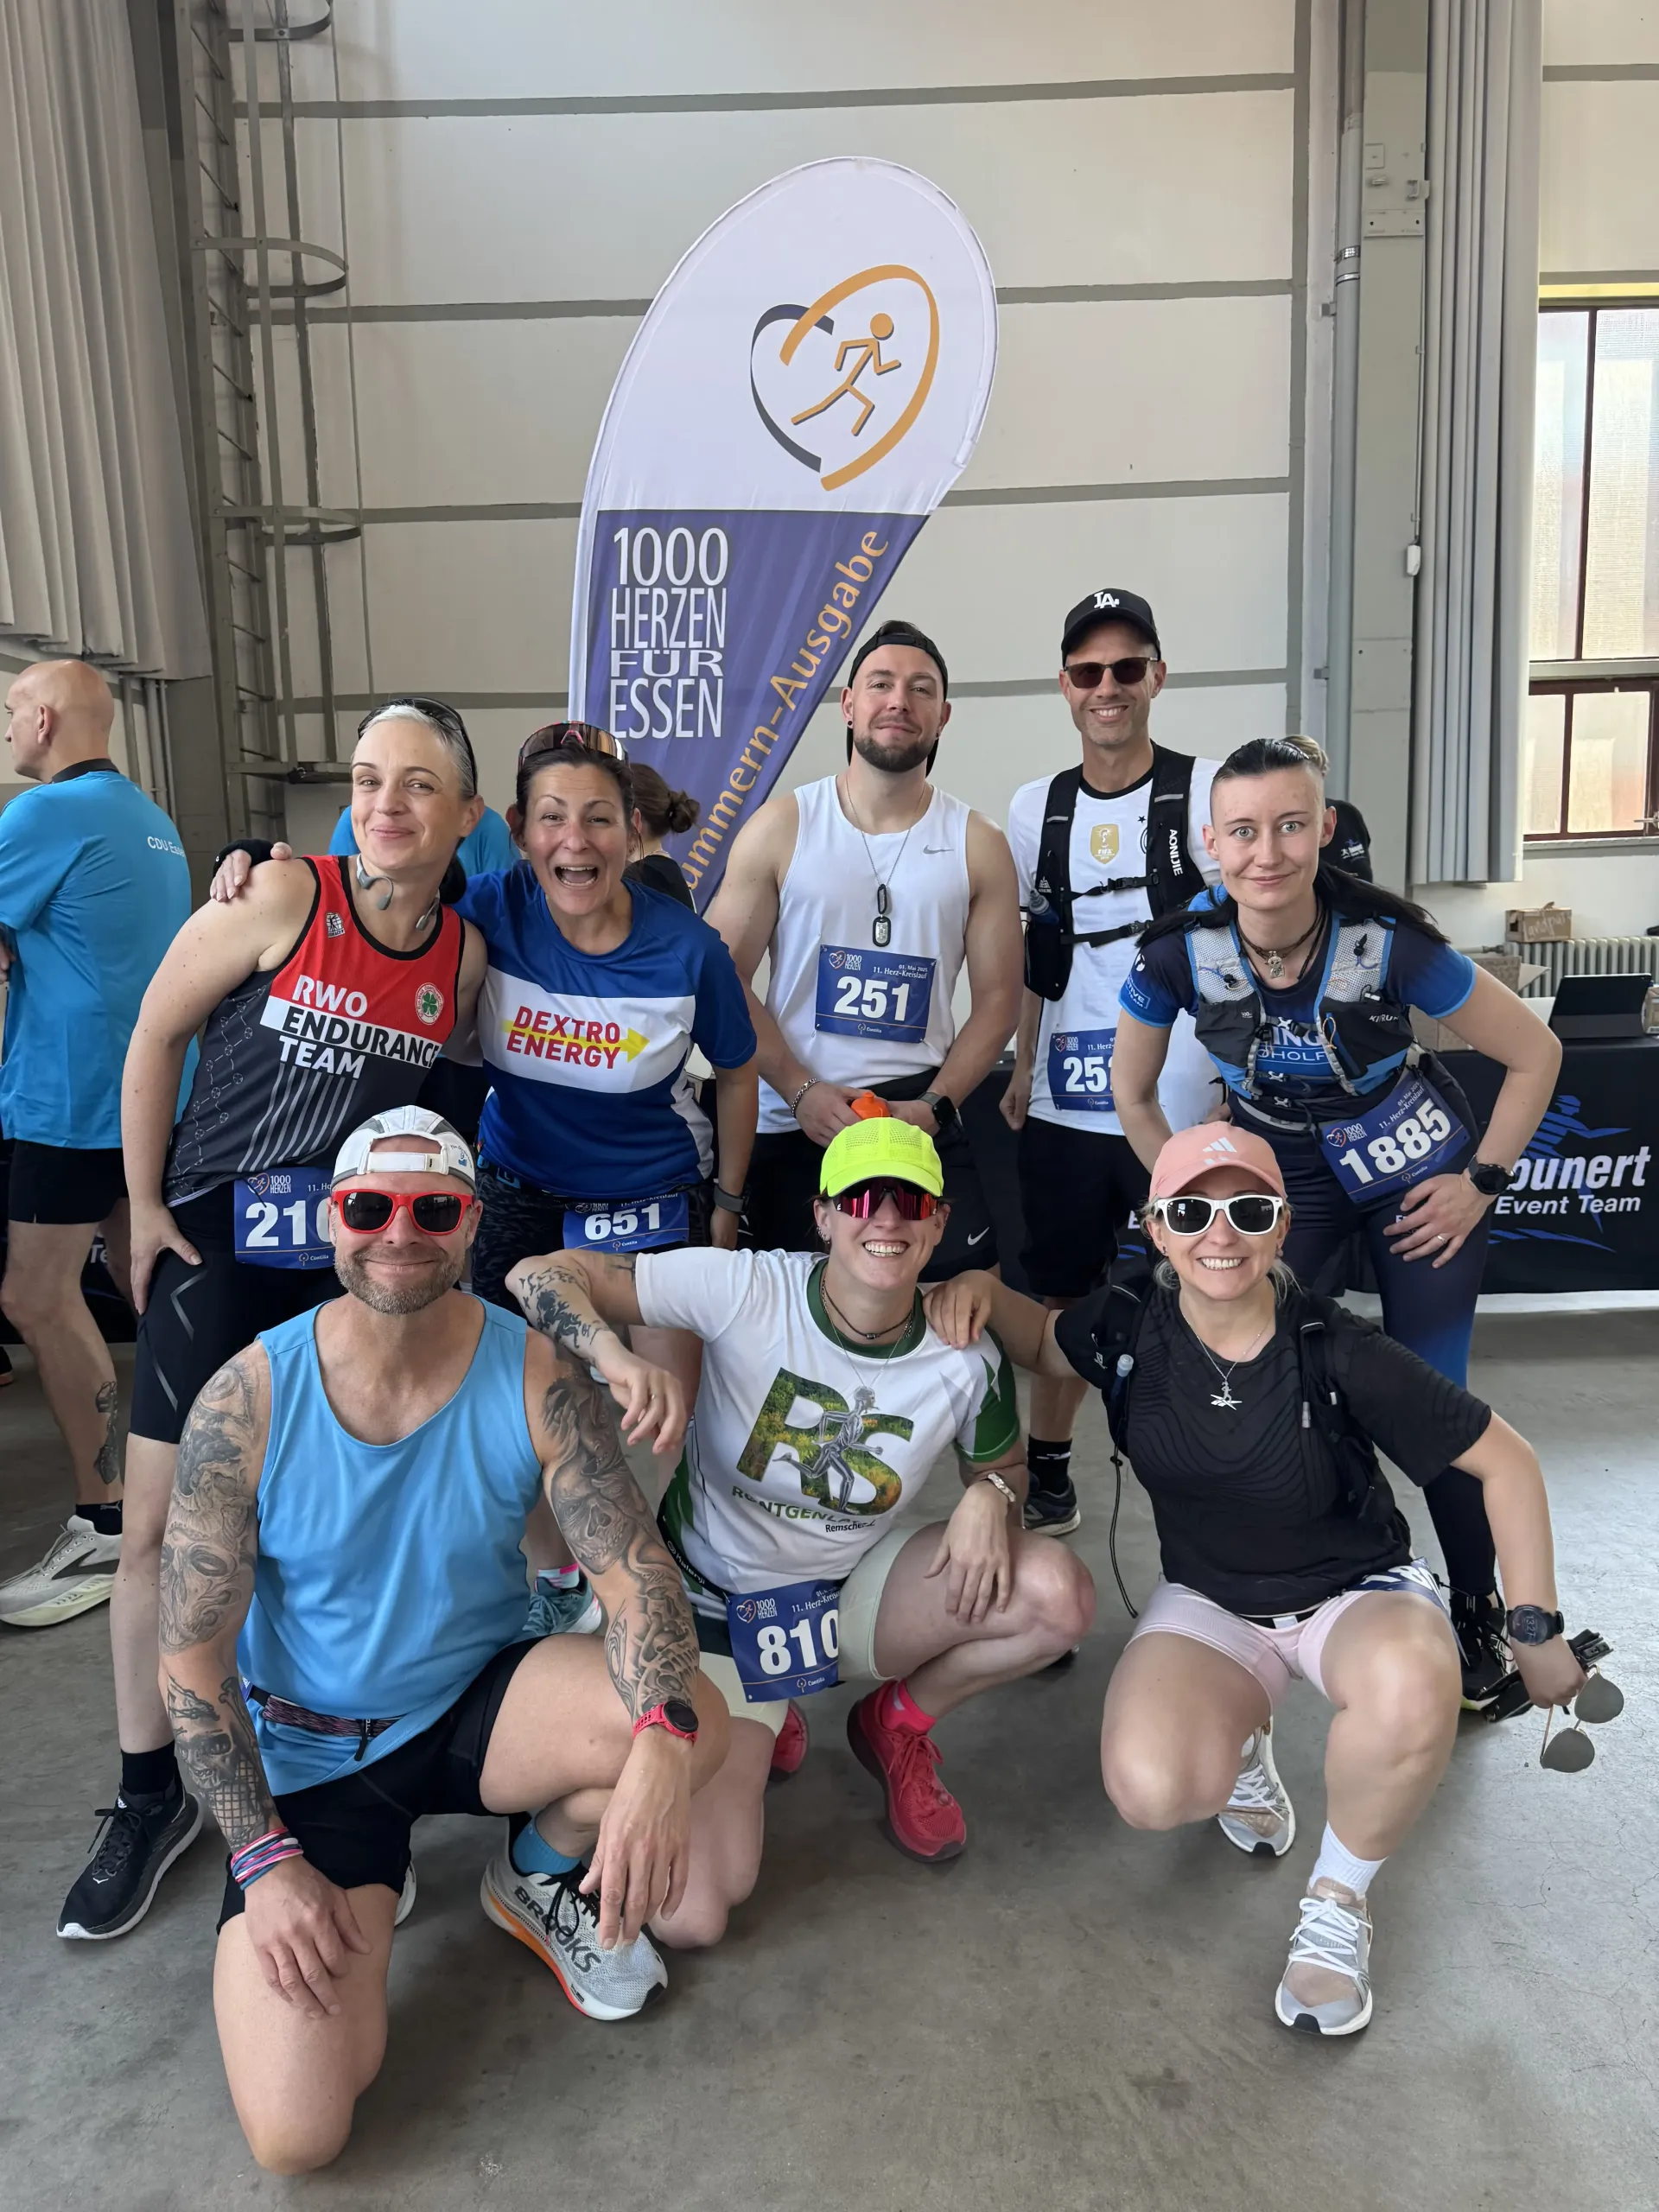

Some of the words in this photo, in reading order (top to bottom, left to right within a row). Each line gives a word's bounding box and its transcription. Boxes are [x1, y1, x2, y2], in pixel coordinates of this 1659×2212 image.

[613, 527, 728, 586] 1000
[1094, 591, 1120, 608] LA
[611, 588, 727, 649] HERZEN
[610, 650, 723, 677] FÜR
[609, 678, 721, 738] ESSEN
[147, 836, 168, 851] CDU
[845, 961, 861, 970] HERZEN
[846, 953, 862, 963] 1000
[884, 967, 928, 979] Herz-Kreislauf
[291, 974, 368, 1018] RWO
[834, 976, 910, 1021] 251
[512, 1006, 620, 1045] DEXTRO
[279, 1035, 366, 1079] TEAM
[506, 1029, 621, 1070] ENERGY
[1063, 1056, 1113, 1092] 25
[1344, 1123, 1363, 1135] 1000
[1378, 1121, 1390, 1129] 11.
[1338, 1097, 1451, 1185] 1885
[270, 1175, 291, 1185] 1000
[270, 1184, 291, 1194] HERZEN
[1494, 1195, 1570, 1215] Event
[1578, 1194, 1641, 1214] Team
[584, 1202, 660, 1241] 651
[756, 1598, 775, 1608] 1000
[757, 1606, 778, 1619] HERZEN
[791, 1605, 804, 1613] 11.
[756, 1609, 838, 1675] 810
[514, 1885, 601, 1974] BROOKS
